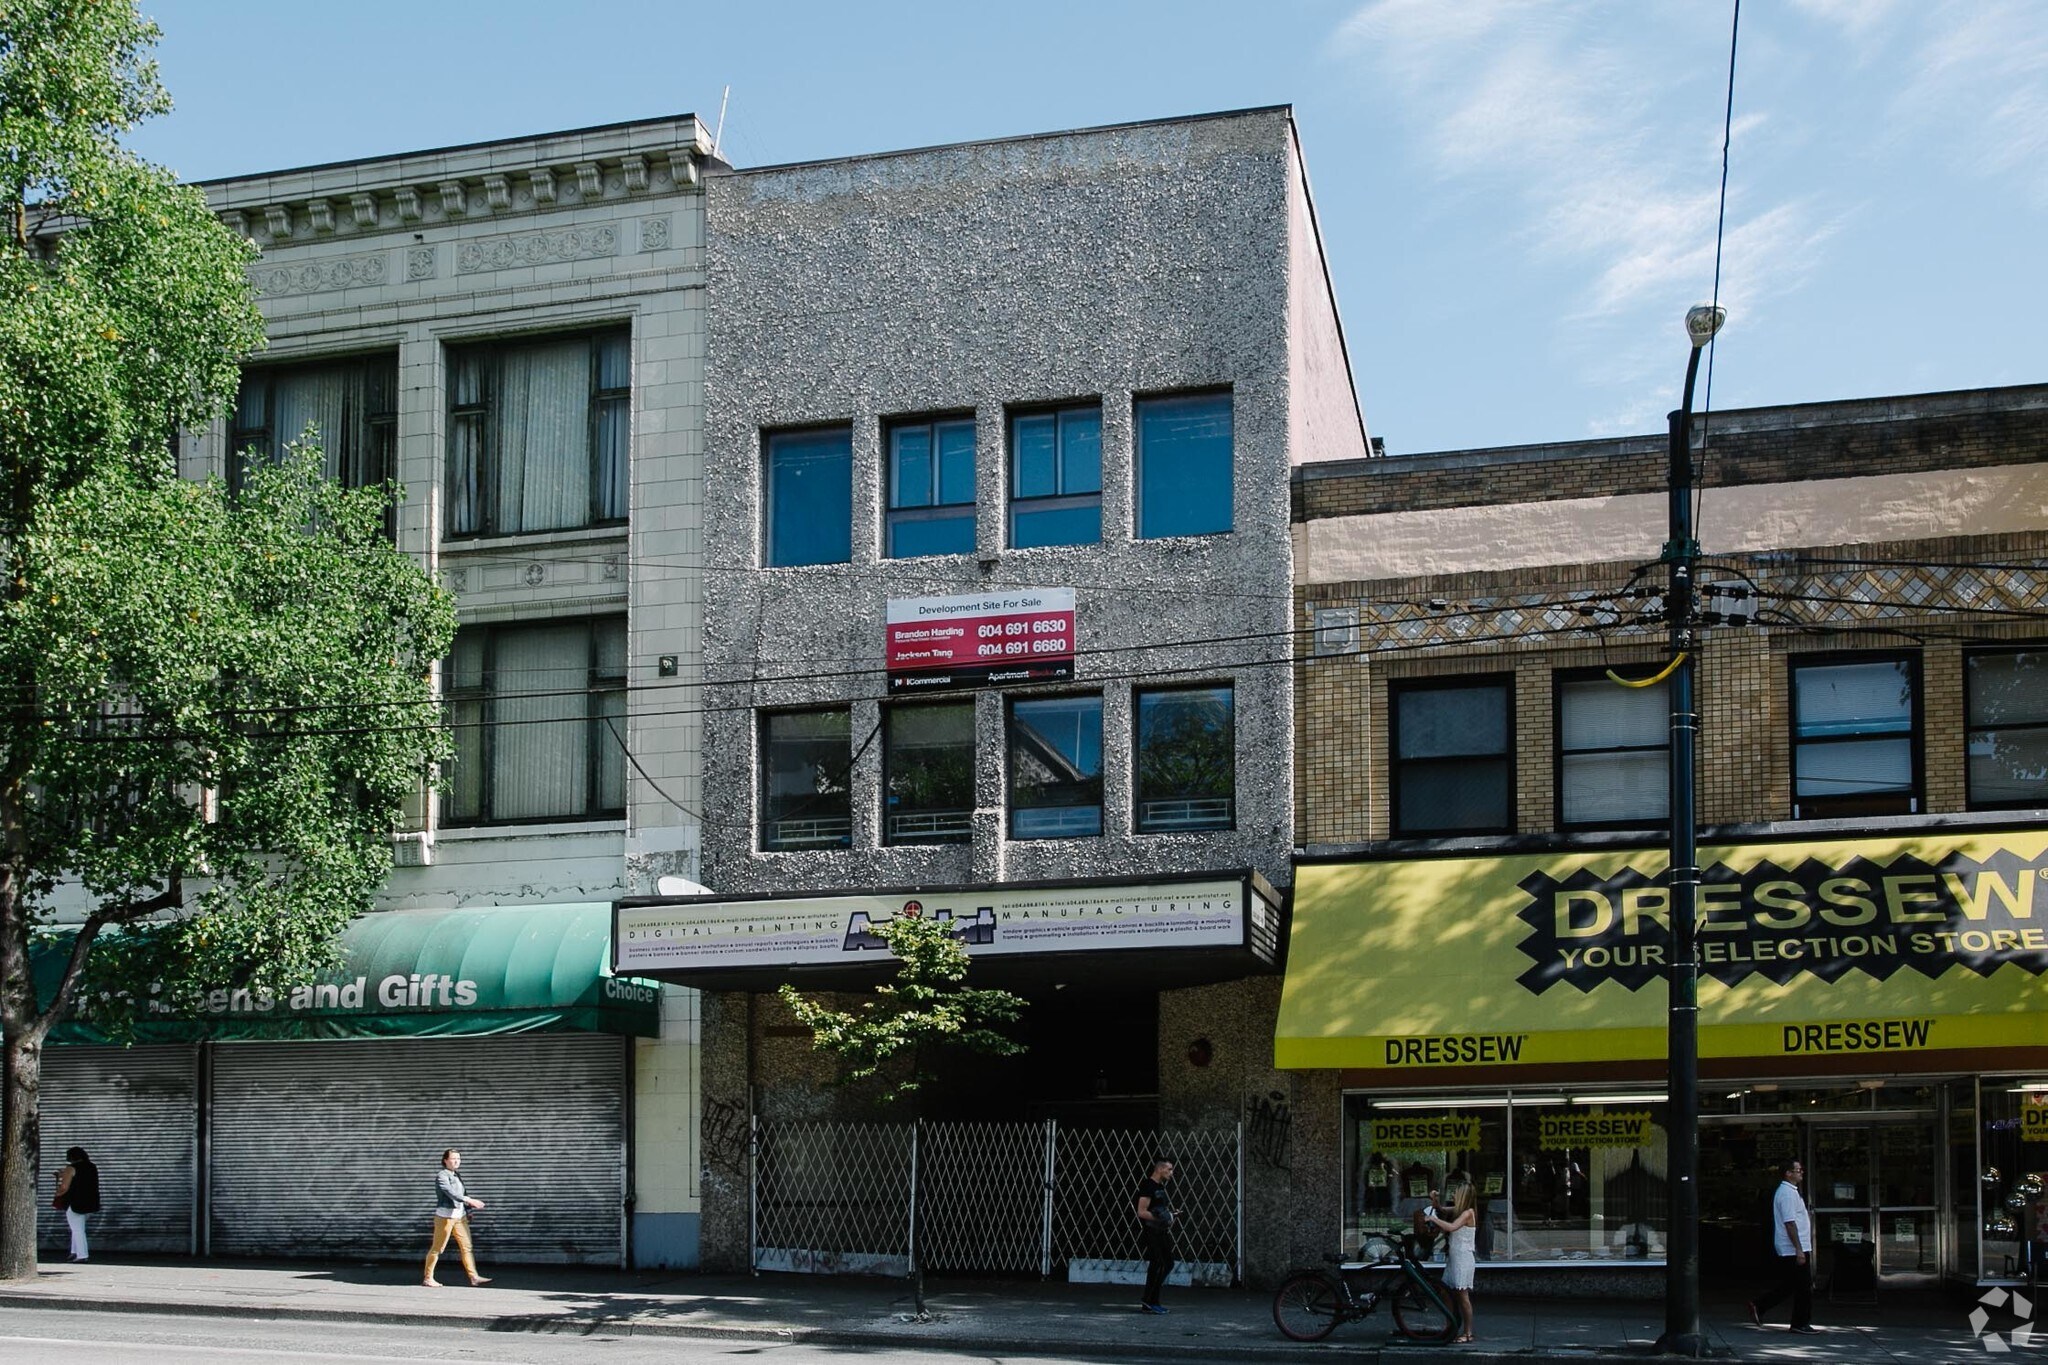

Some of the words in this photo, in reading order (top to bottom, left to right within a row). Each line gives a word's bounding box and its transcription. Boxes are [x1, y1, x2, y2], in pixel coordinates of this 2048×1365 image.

[919, 603, 980, 615] Development
[983, 601, 1000, 610] Site
[1003, 599, 1019, 608] For
[1021, 598, 1042, 607] Sale
[895, 630, 930, 640] Brandon
[931, 627, 964, 637] Harding
[978, 624, 1003, 638] 604
[1005, 621, 1028, 635] 691
[1033, 619, 1066, 633] 6630
[895, 651, 930, 661] Jackson
[932, 649, 953, 659] Tang
[978, 643, 1003, 657] 604
[1005, 641, 1028, 655] 691
[1033, 638, 1066, 653] 6680
[1002, 900, 1231, 919] MANUFACTURING
[1555, 869, 2036, 939] DRESSEW
[629, 927, 712, 939] DIGITAL
[735, 921, 838, 933] PRINTING
[1558, 944, 1667, 969] YOUR
[1696, 934, 1898, 964] ELECTION
[1910, 928, 2048, 954] STORE
[289, 976, 366, 1010] and
[378, 974, 477, 1009] Gifts
[605, 978, 654, 1003] Choice
[1783, 1020, 1930, 1052] DRESSEW
[1386, 1035, 1523, 1065] DRESSEW
[1376, 1123, 1471, 1140] DRESSEW
[1544, 1119, 1642, 1136] DRESSEW
[2028, 1127, 2048, 1135] YOU
[1378, 1141, 1398, 1149] YOUR
[1400, 1140, 1443, 1148] SELECTION
[1444, 1139, 1470, 1147] STORE
[1545, 1137, 1568, 1145] YOUR
[1569, 1136, 1614, 1145] SELECTION
